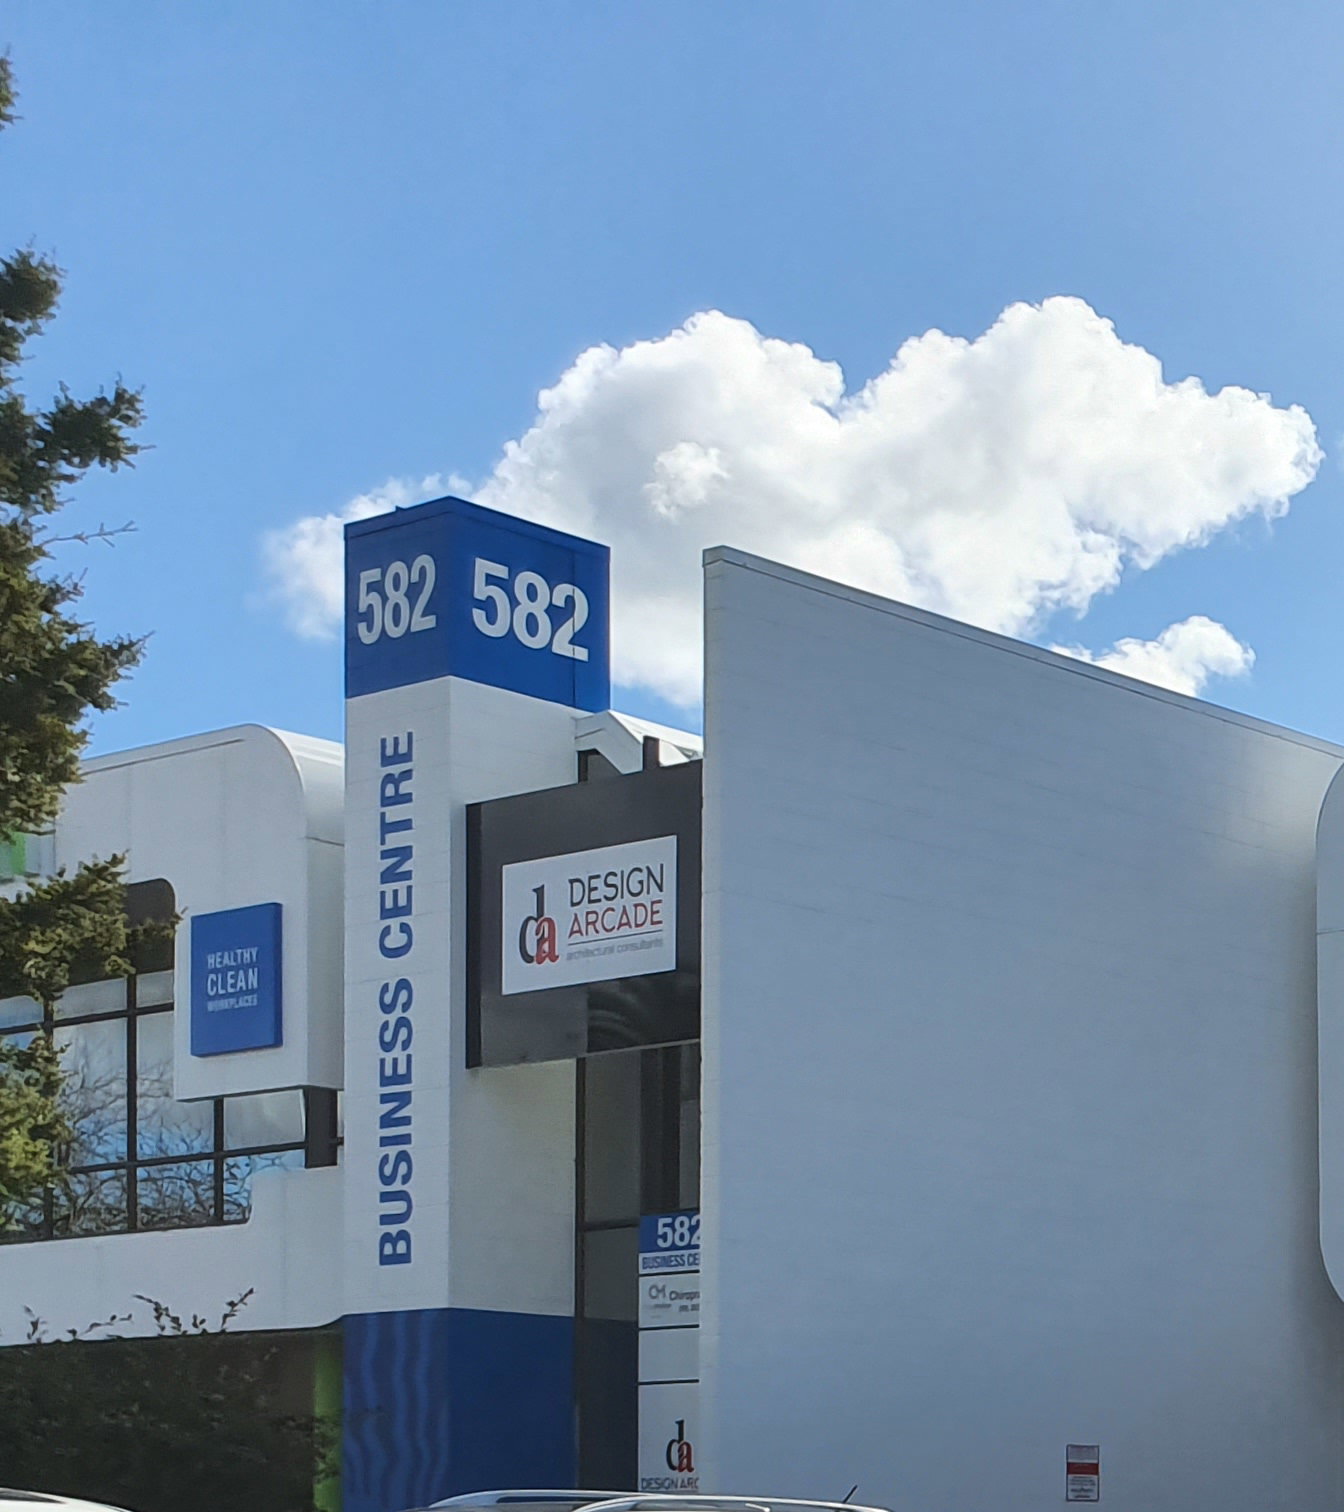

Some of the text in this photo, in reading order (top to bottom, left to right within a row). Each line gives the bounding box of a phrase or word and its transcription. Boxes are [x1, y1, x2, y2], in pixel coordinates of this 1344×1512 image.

[357, 554, 437, 645] 582
[472, 556, 590, 662] 582
[568, 863, 664, 908] DESIGN
[568, 899, 663, 939] ARCADE
[207, 946, 258, 970] HEALTHY
[207, 967, 259, 997] CLEAN
[378, 730, 414, 1266] BUSINESS CENTRE
[656, 1215, 700, 1248] 582
[642, 1255, 685, 1270] BUSINESS
[641, 1478, 678, 1490] DESIGN
